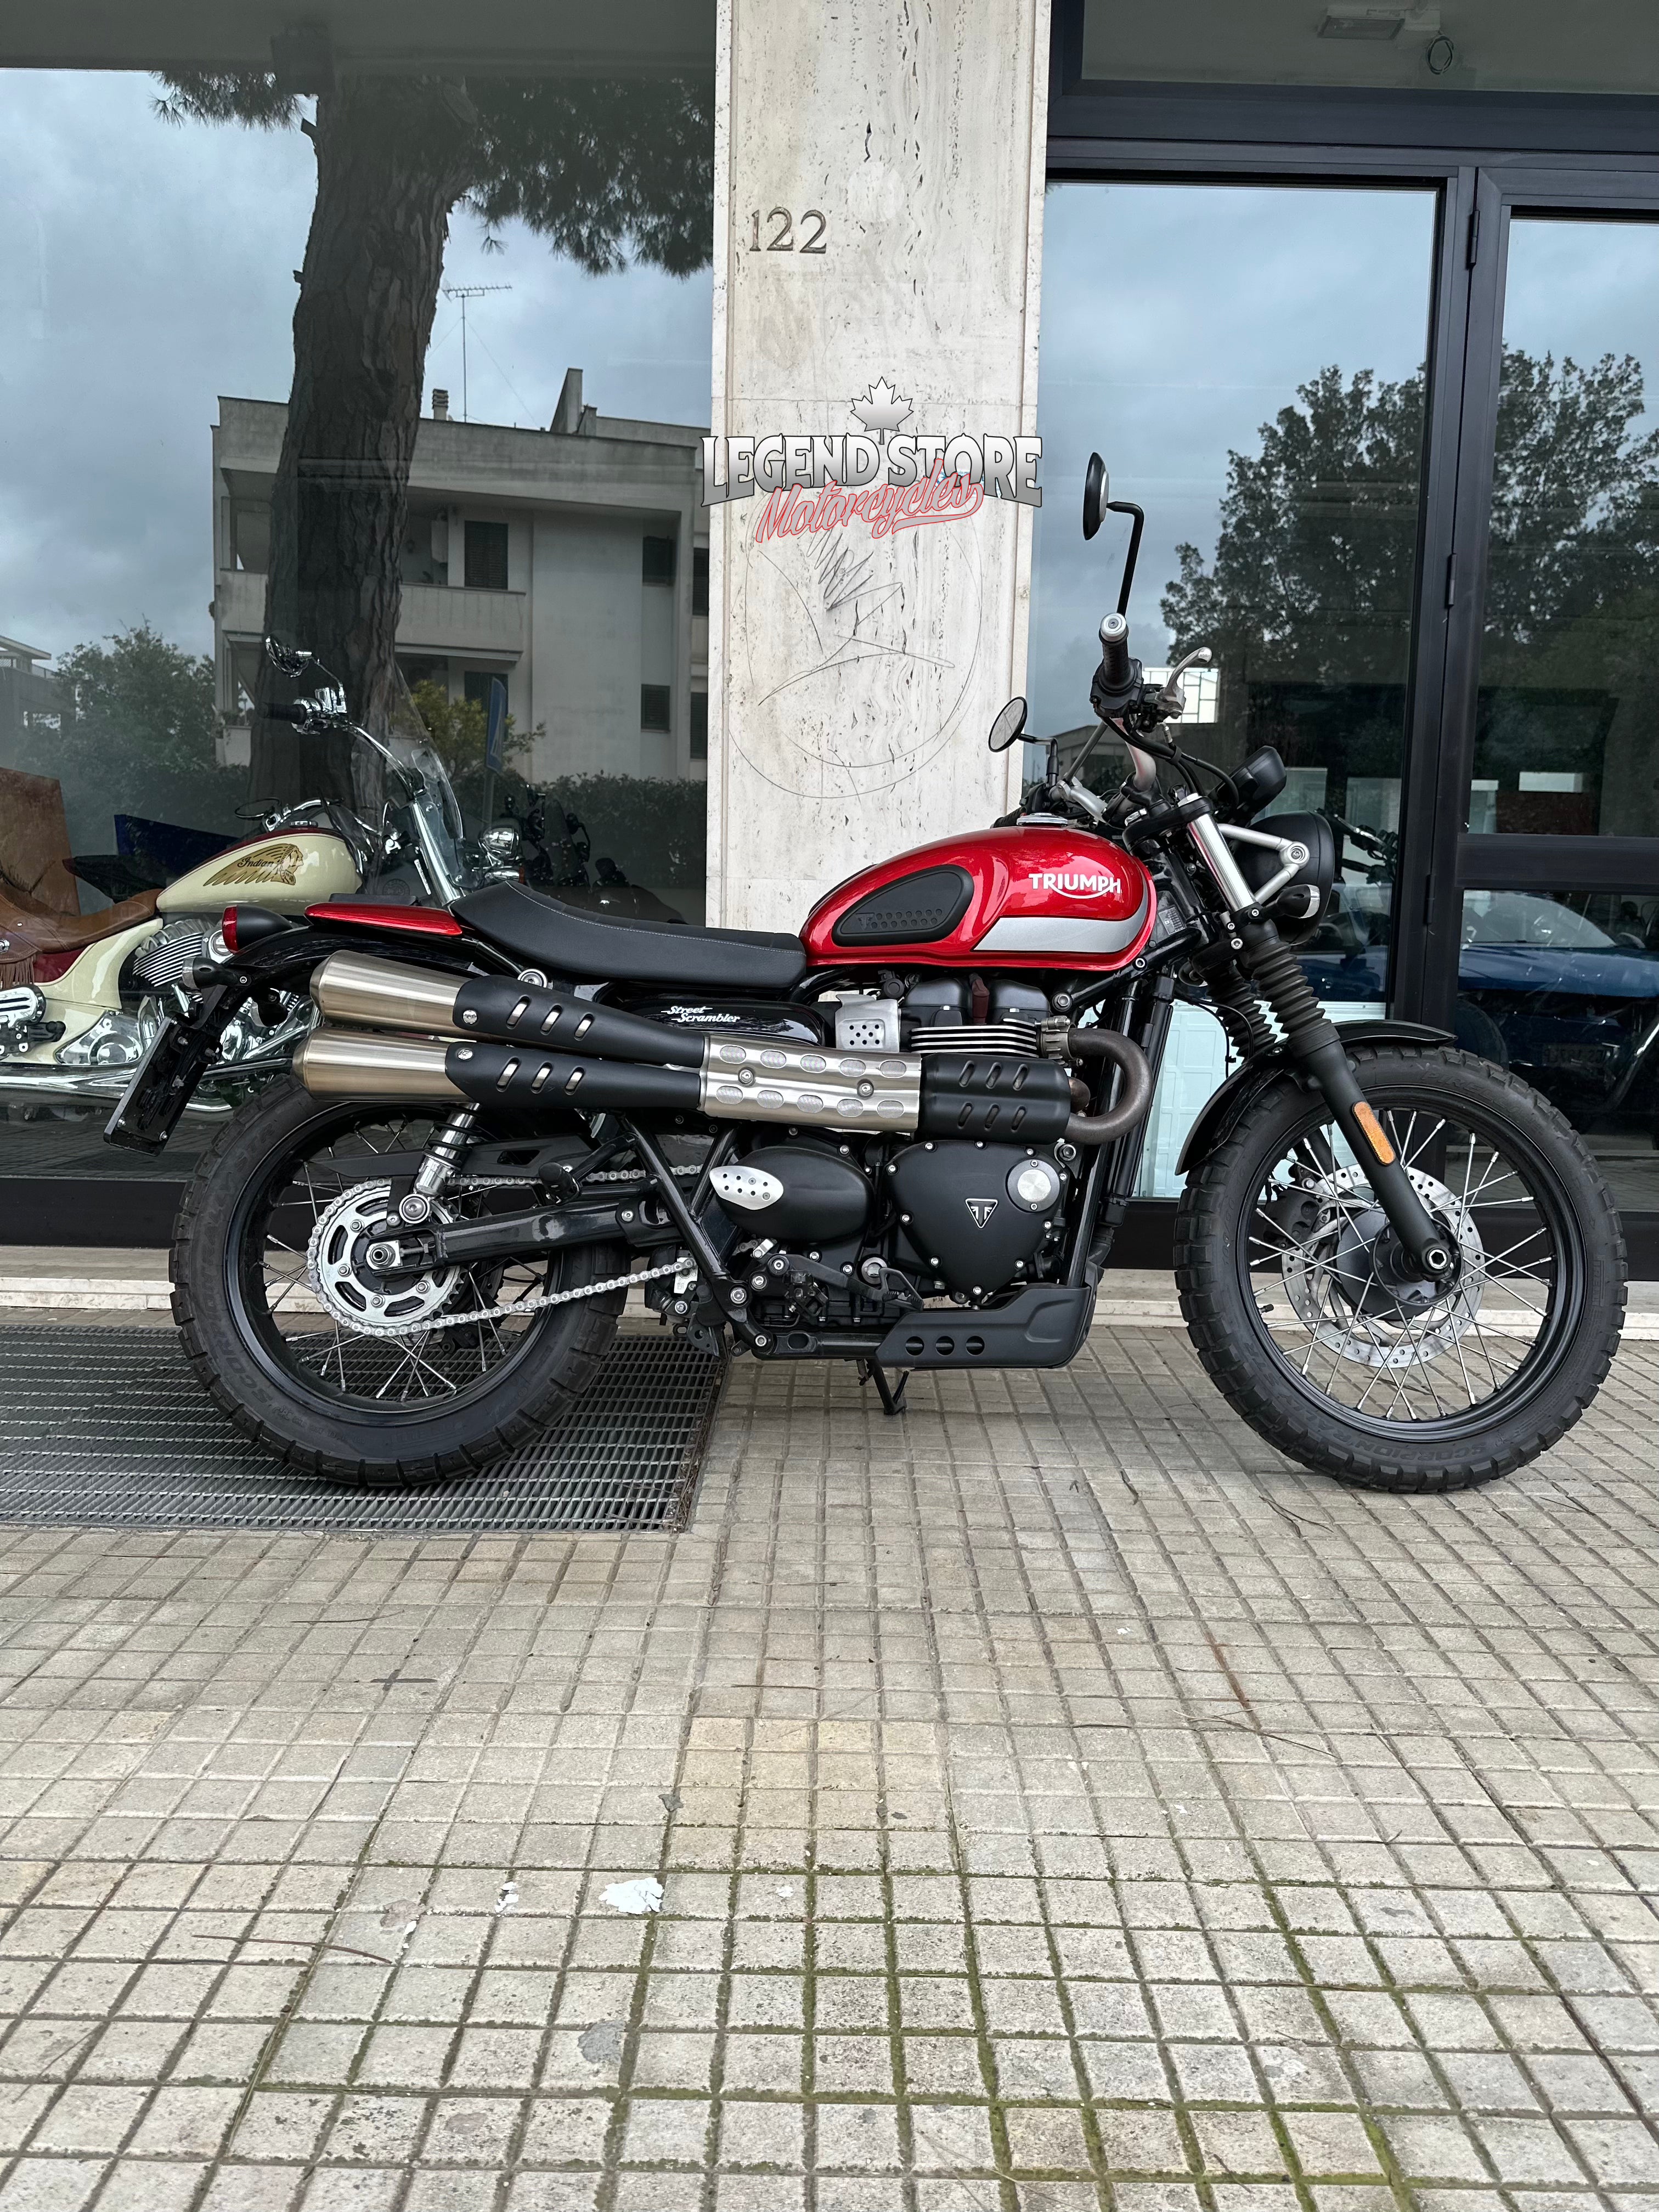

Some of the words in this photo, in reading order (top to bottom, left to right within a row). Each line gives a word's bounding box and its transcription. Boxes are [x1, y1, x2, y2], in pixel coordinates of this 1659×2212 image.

[750, 207, 827, 254] 122
[238, 856, 274, 867] Indian
[1029, 873, 1121, 899] TRIUMPH
[661, 1006, 713, 1014] Street
[672, 1013, 741, 1023] Scrambler
[1421, 1070, 1520, 1113] PIRELLI
[1356, 1439, 1489, 1462] SCORPION
